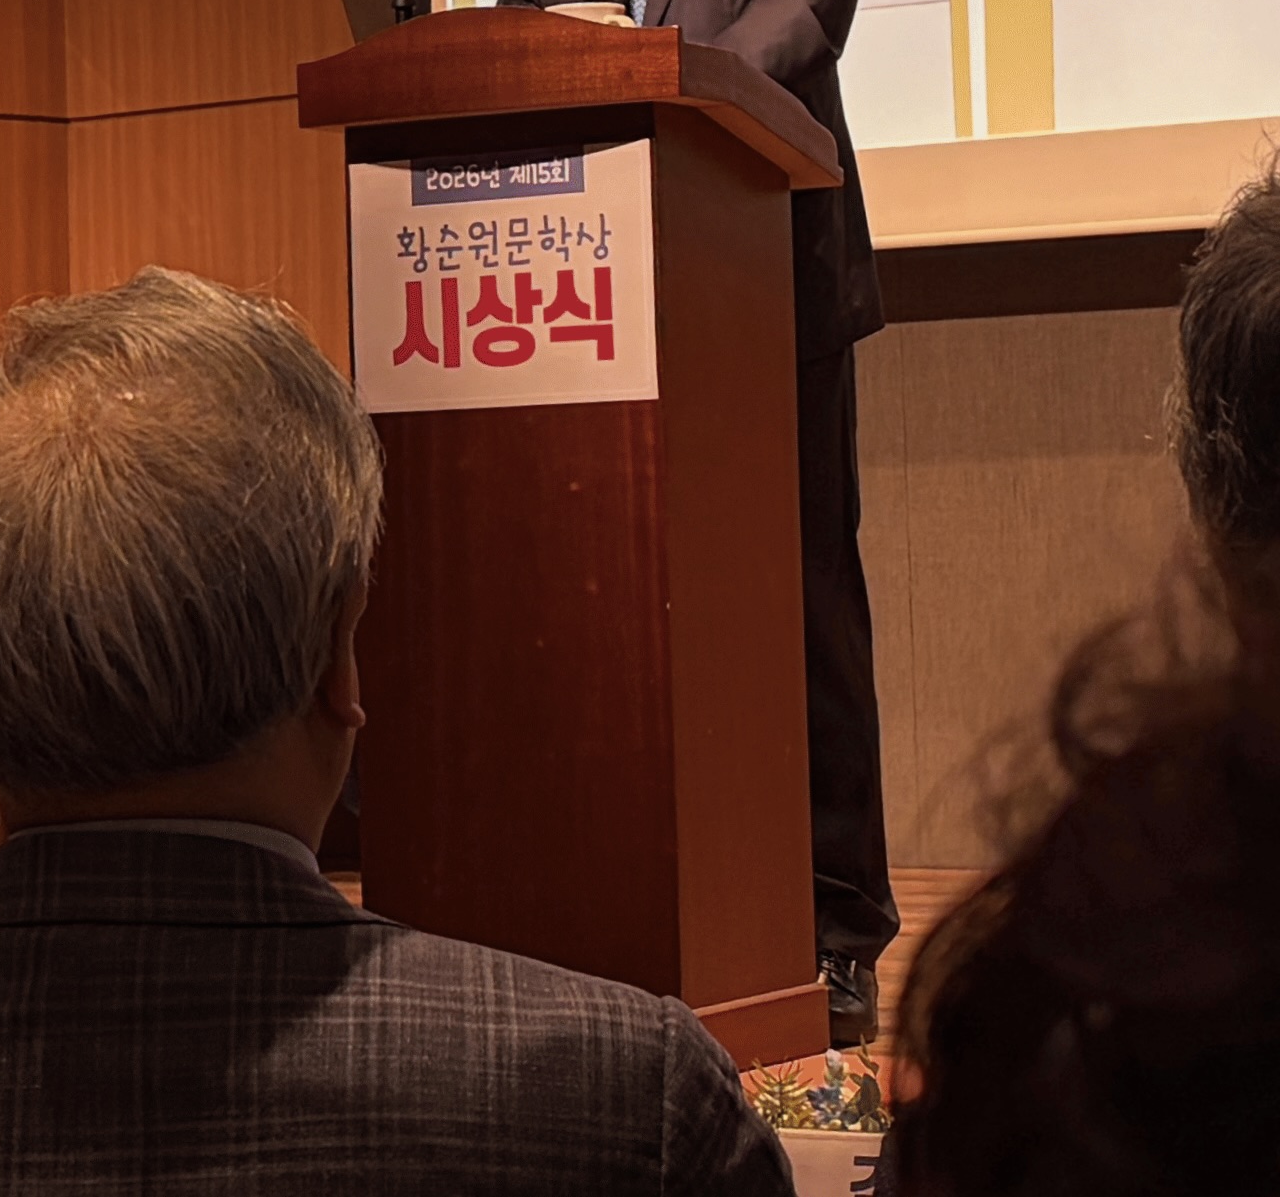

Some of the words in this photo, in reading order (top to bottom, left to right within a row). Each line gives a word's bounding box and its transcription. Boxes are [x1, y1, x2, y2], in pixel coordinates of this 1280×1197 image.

[426, 160, 501, 191] 2026년
[509, 156, 570, 185] 제15회
[397, 213, 612, 273] 황순원문학상
[392, 266, 616, 369] 시상식
